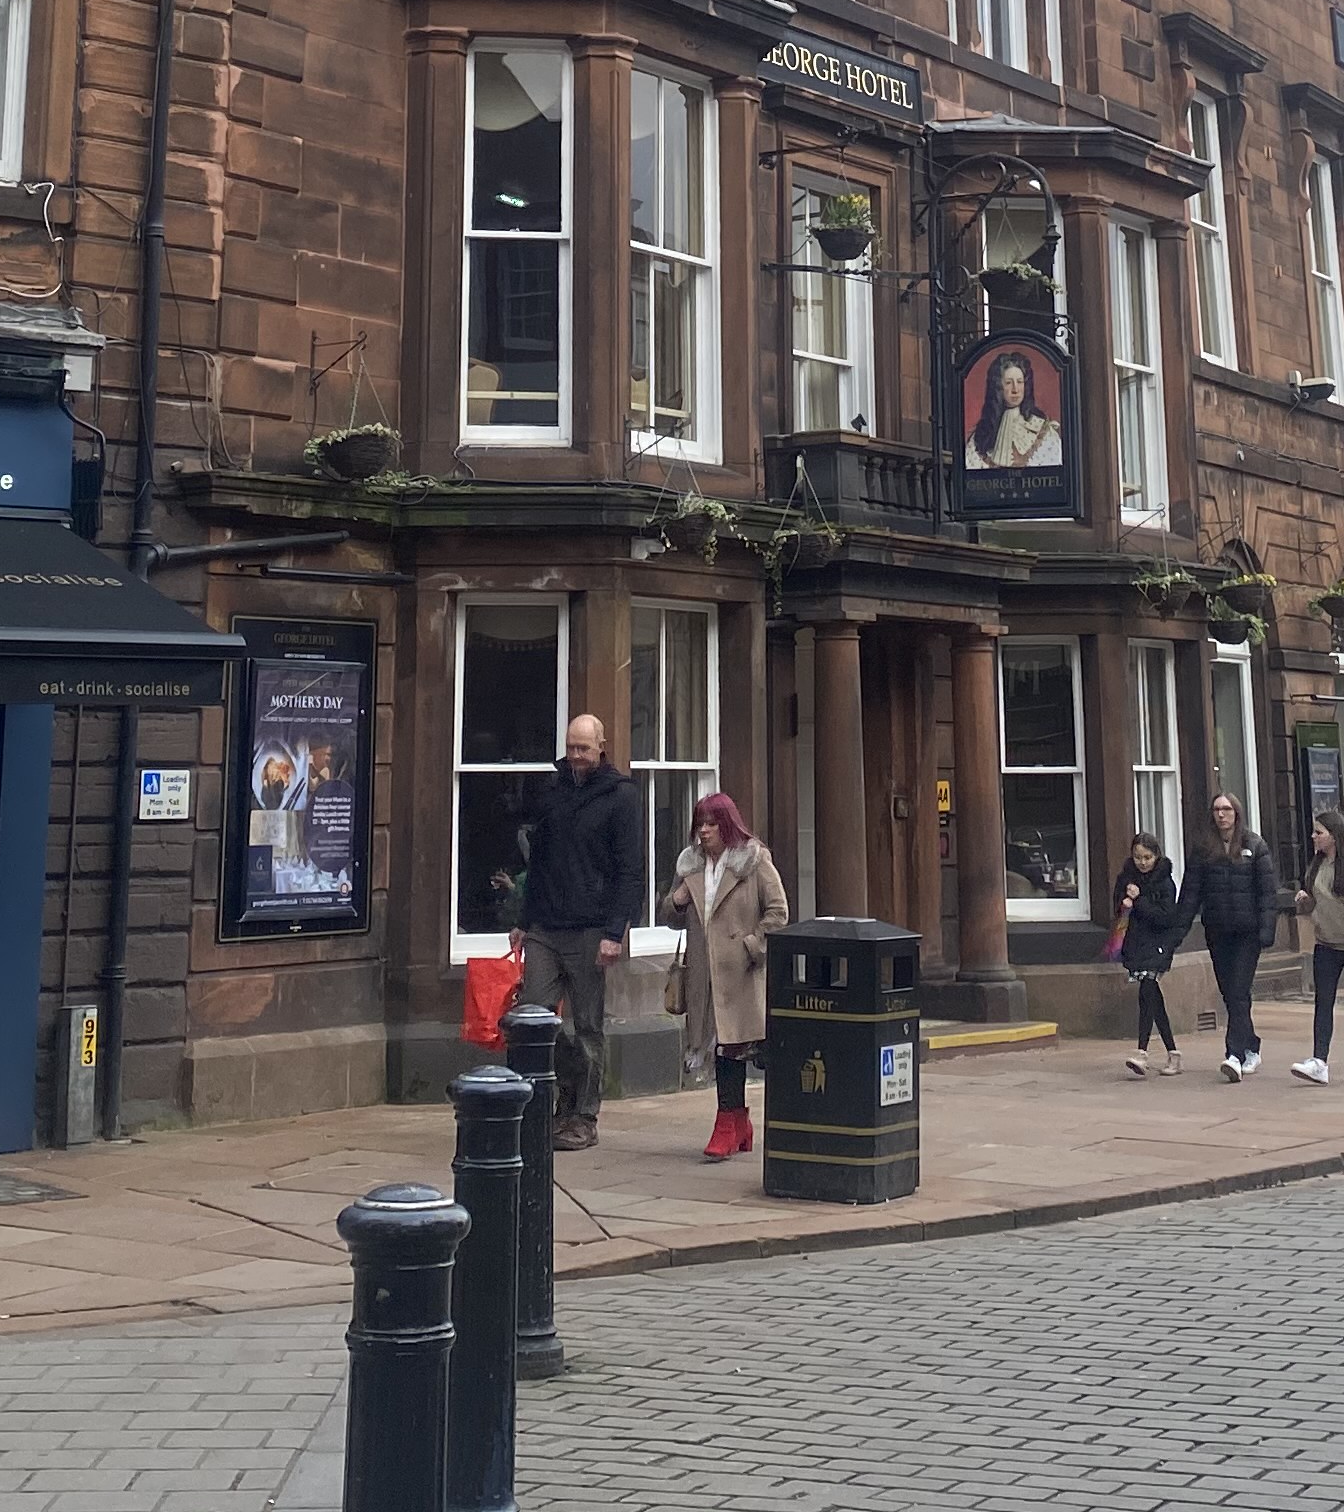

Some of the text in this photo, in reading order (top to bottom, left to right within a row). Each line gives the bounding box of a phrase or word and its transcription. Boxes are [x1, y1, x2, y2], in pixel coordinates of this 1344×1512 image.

[845, 62, 913, 110] HOTEL
[966, 475, 1064, 490] GEORGE HOTEL
[39, 679, 190, 696] eat drink socialise
[270, 694, 344, 709] MOTHER'S DAY
[163, 774, 187, 784] Loading
[168, 798, 180, 806] Sat
[796, 994, 834, 1011] Litter
